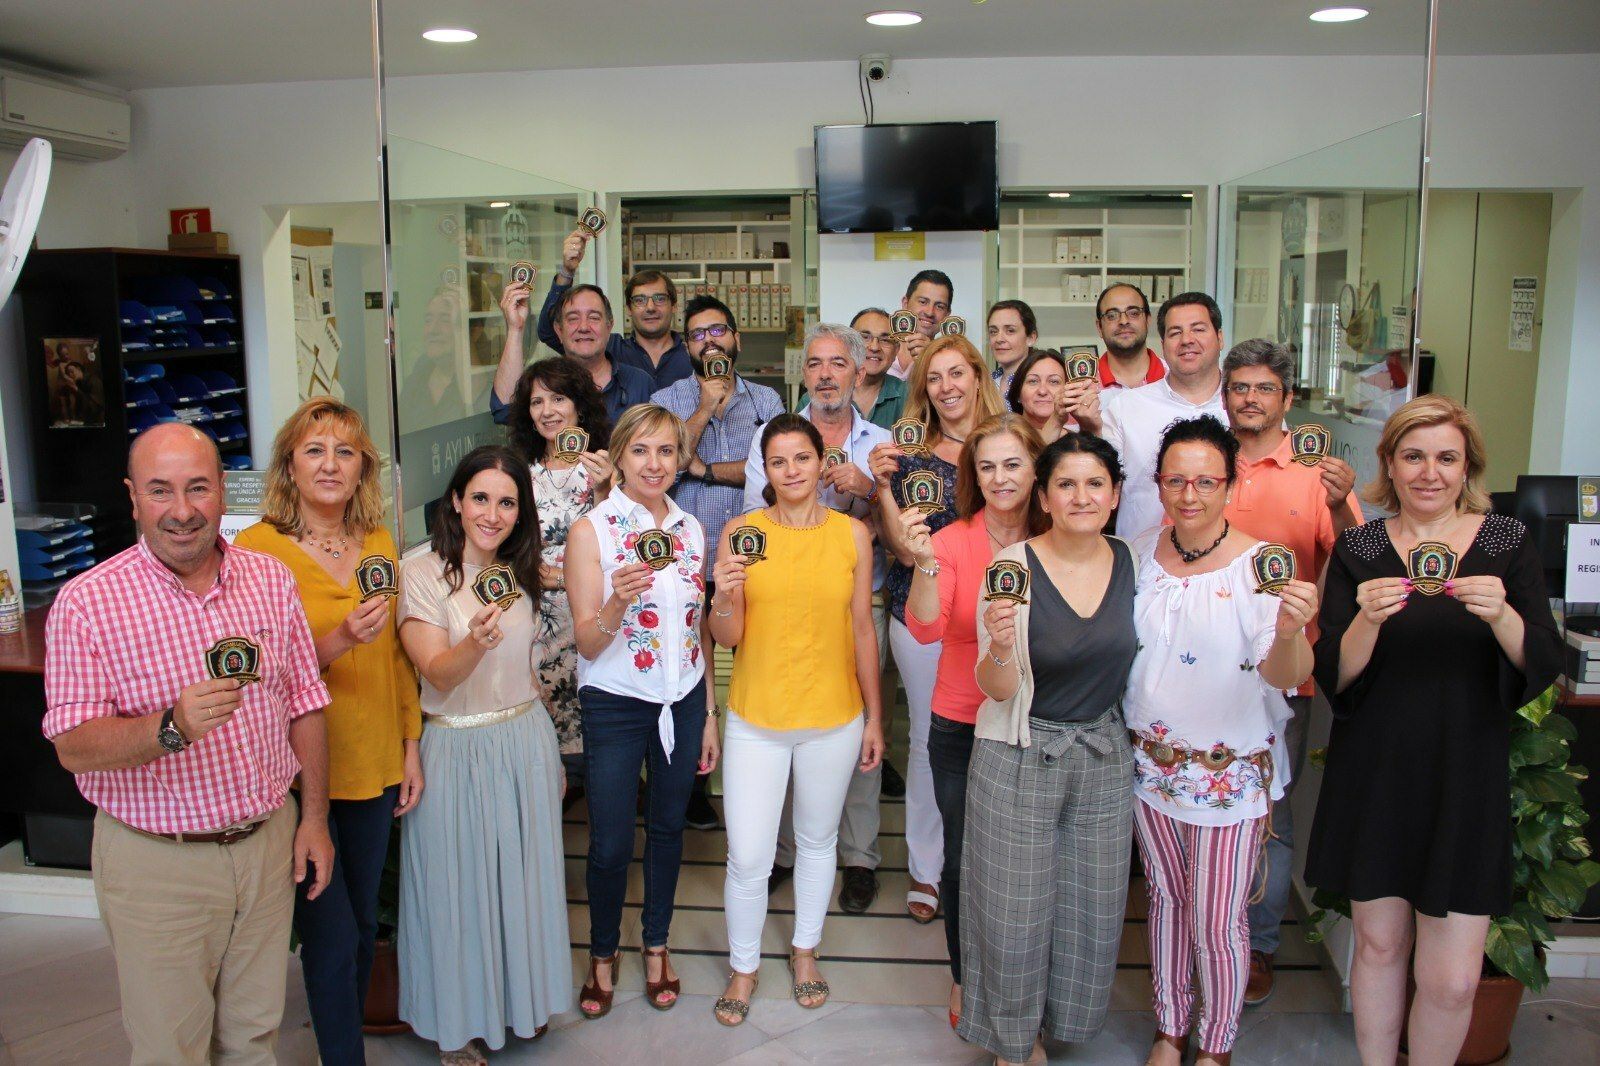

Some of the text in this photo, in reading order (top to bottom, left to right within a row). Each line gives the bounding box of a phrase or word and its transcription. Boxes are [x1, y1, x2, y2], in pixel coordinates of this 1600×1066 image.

[444, 434, 475, 470] AYUN
[1589, 538, 1600, 546] IN
[1577, 564, 1600, 573] REGI
